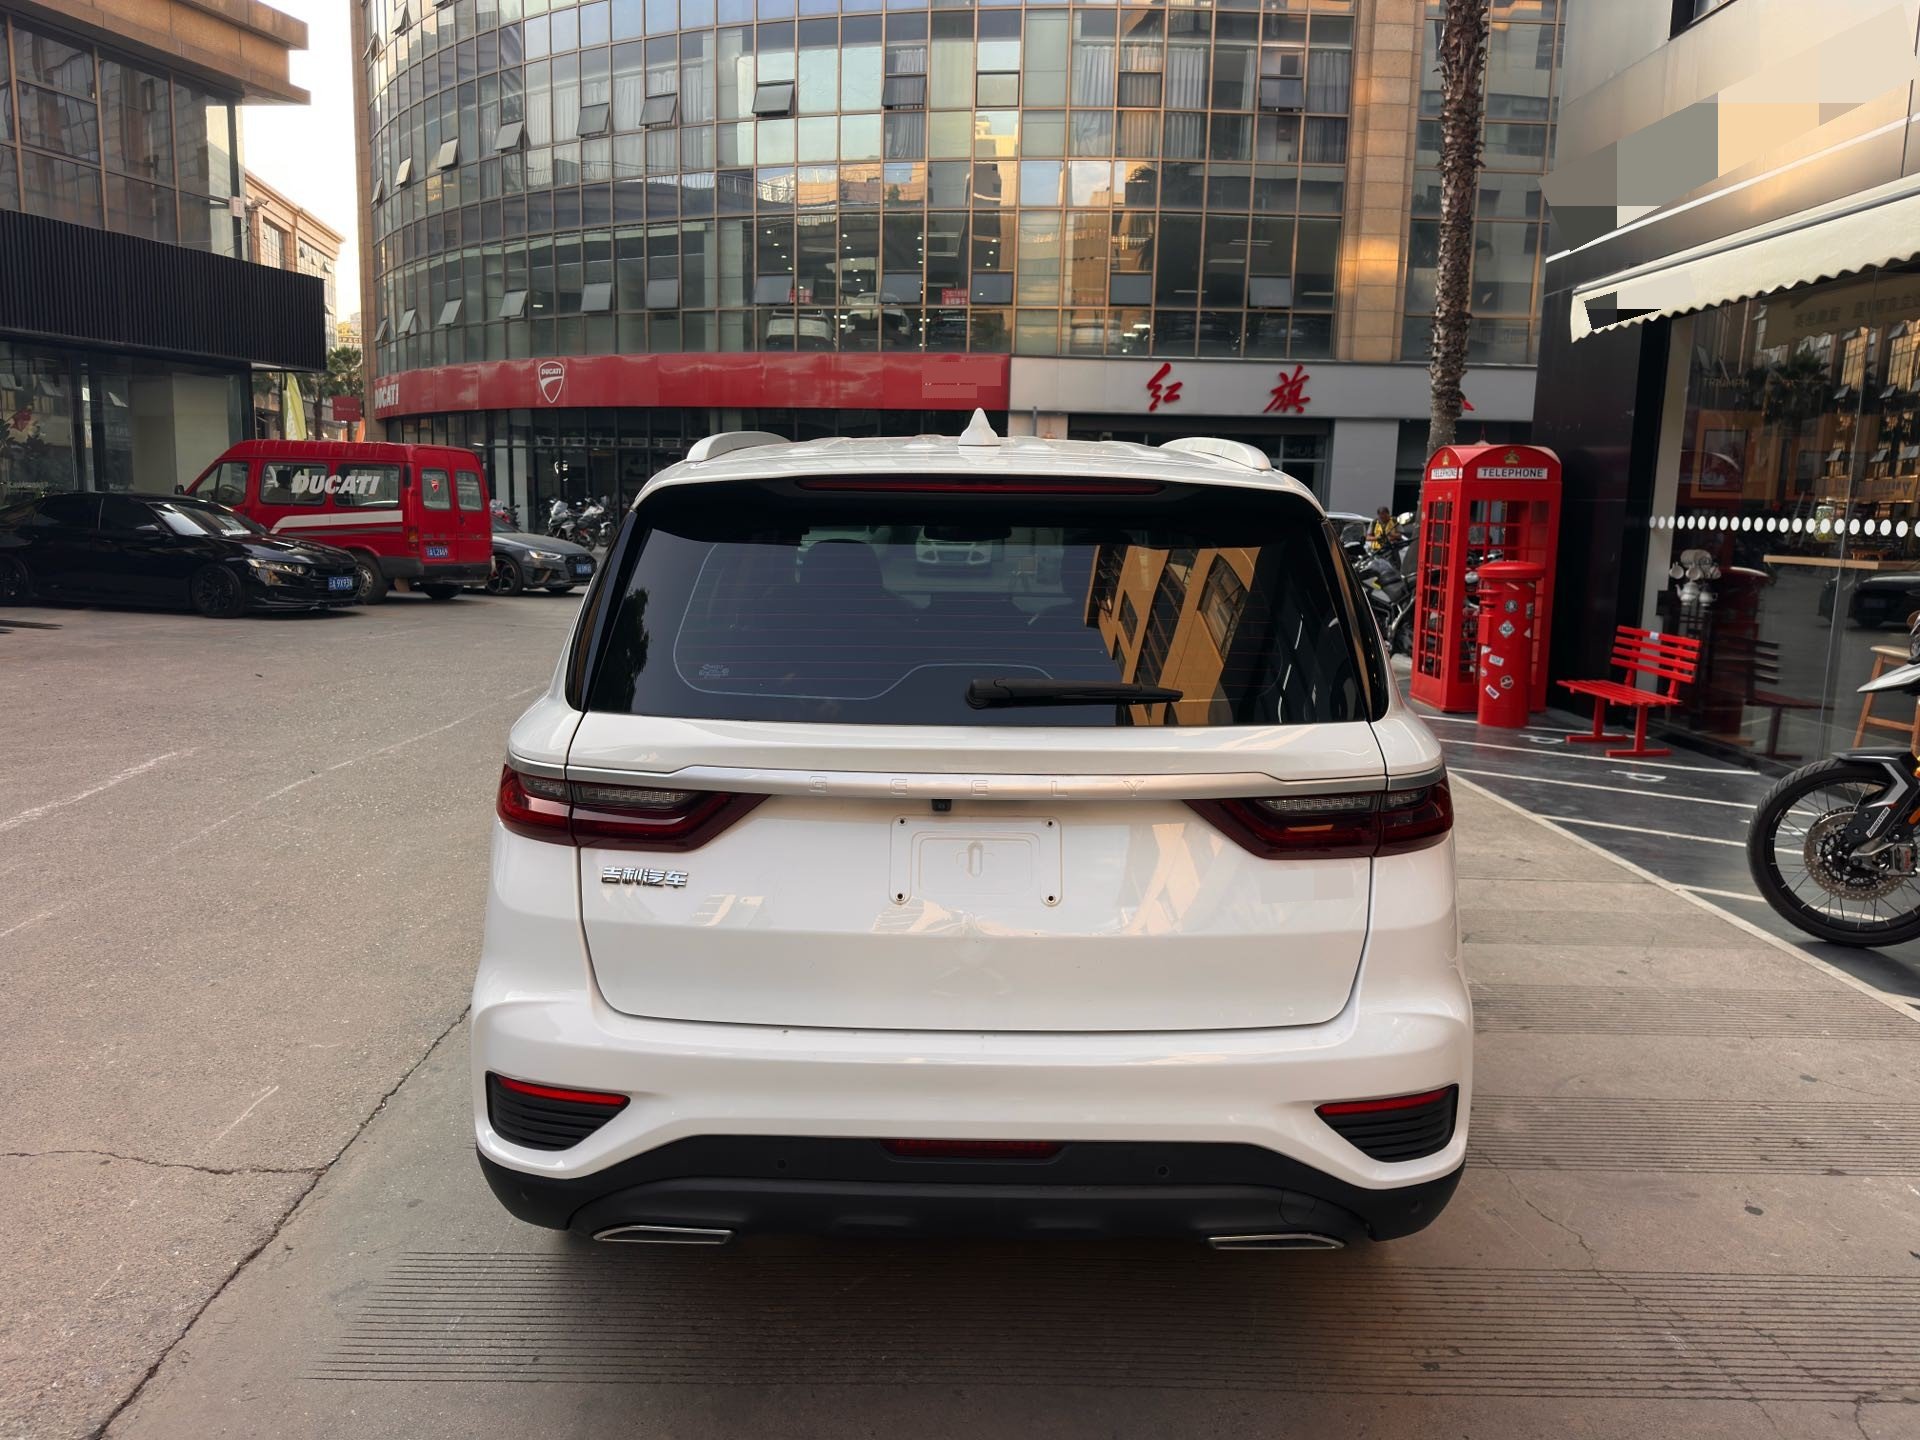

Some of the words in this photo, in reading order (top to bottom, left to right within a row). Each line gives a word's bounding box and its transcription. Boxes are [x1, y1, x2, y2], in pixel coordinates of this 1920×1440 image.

[375, 384, 399, 409] DUCATI
[1147, 363, 1311, 414] 红旗
[1483, 468, 1543, 478] TELEPHONE
[291, 474, 380, 494] DUCATI
[808, 775, 1145, 797] GEELY
[601, 867, 688, 888] 吉利汽车
